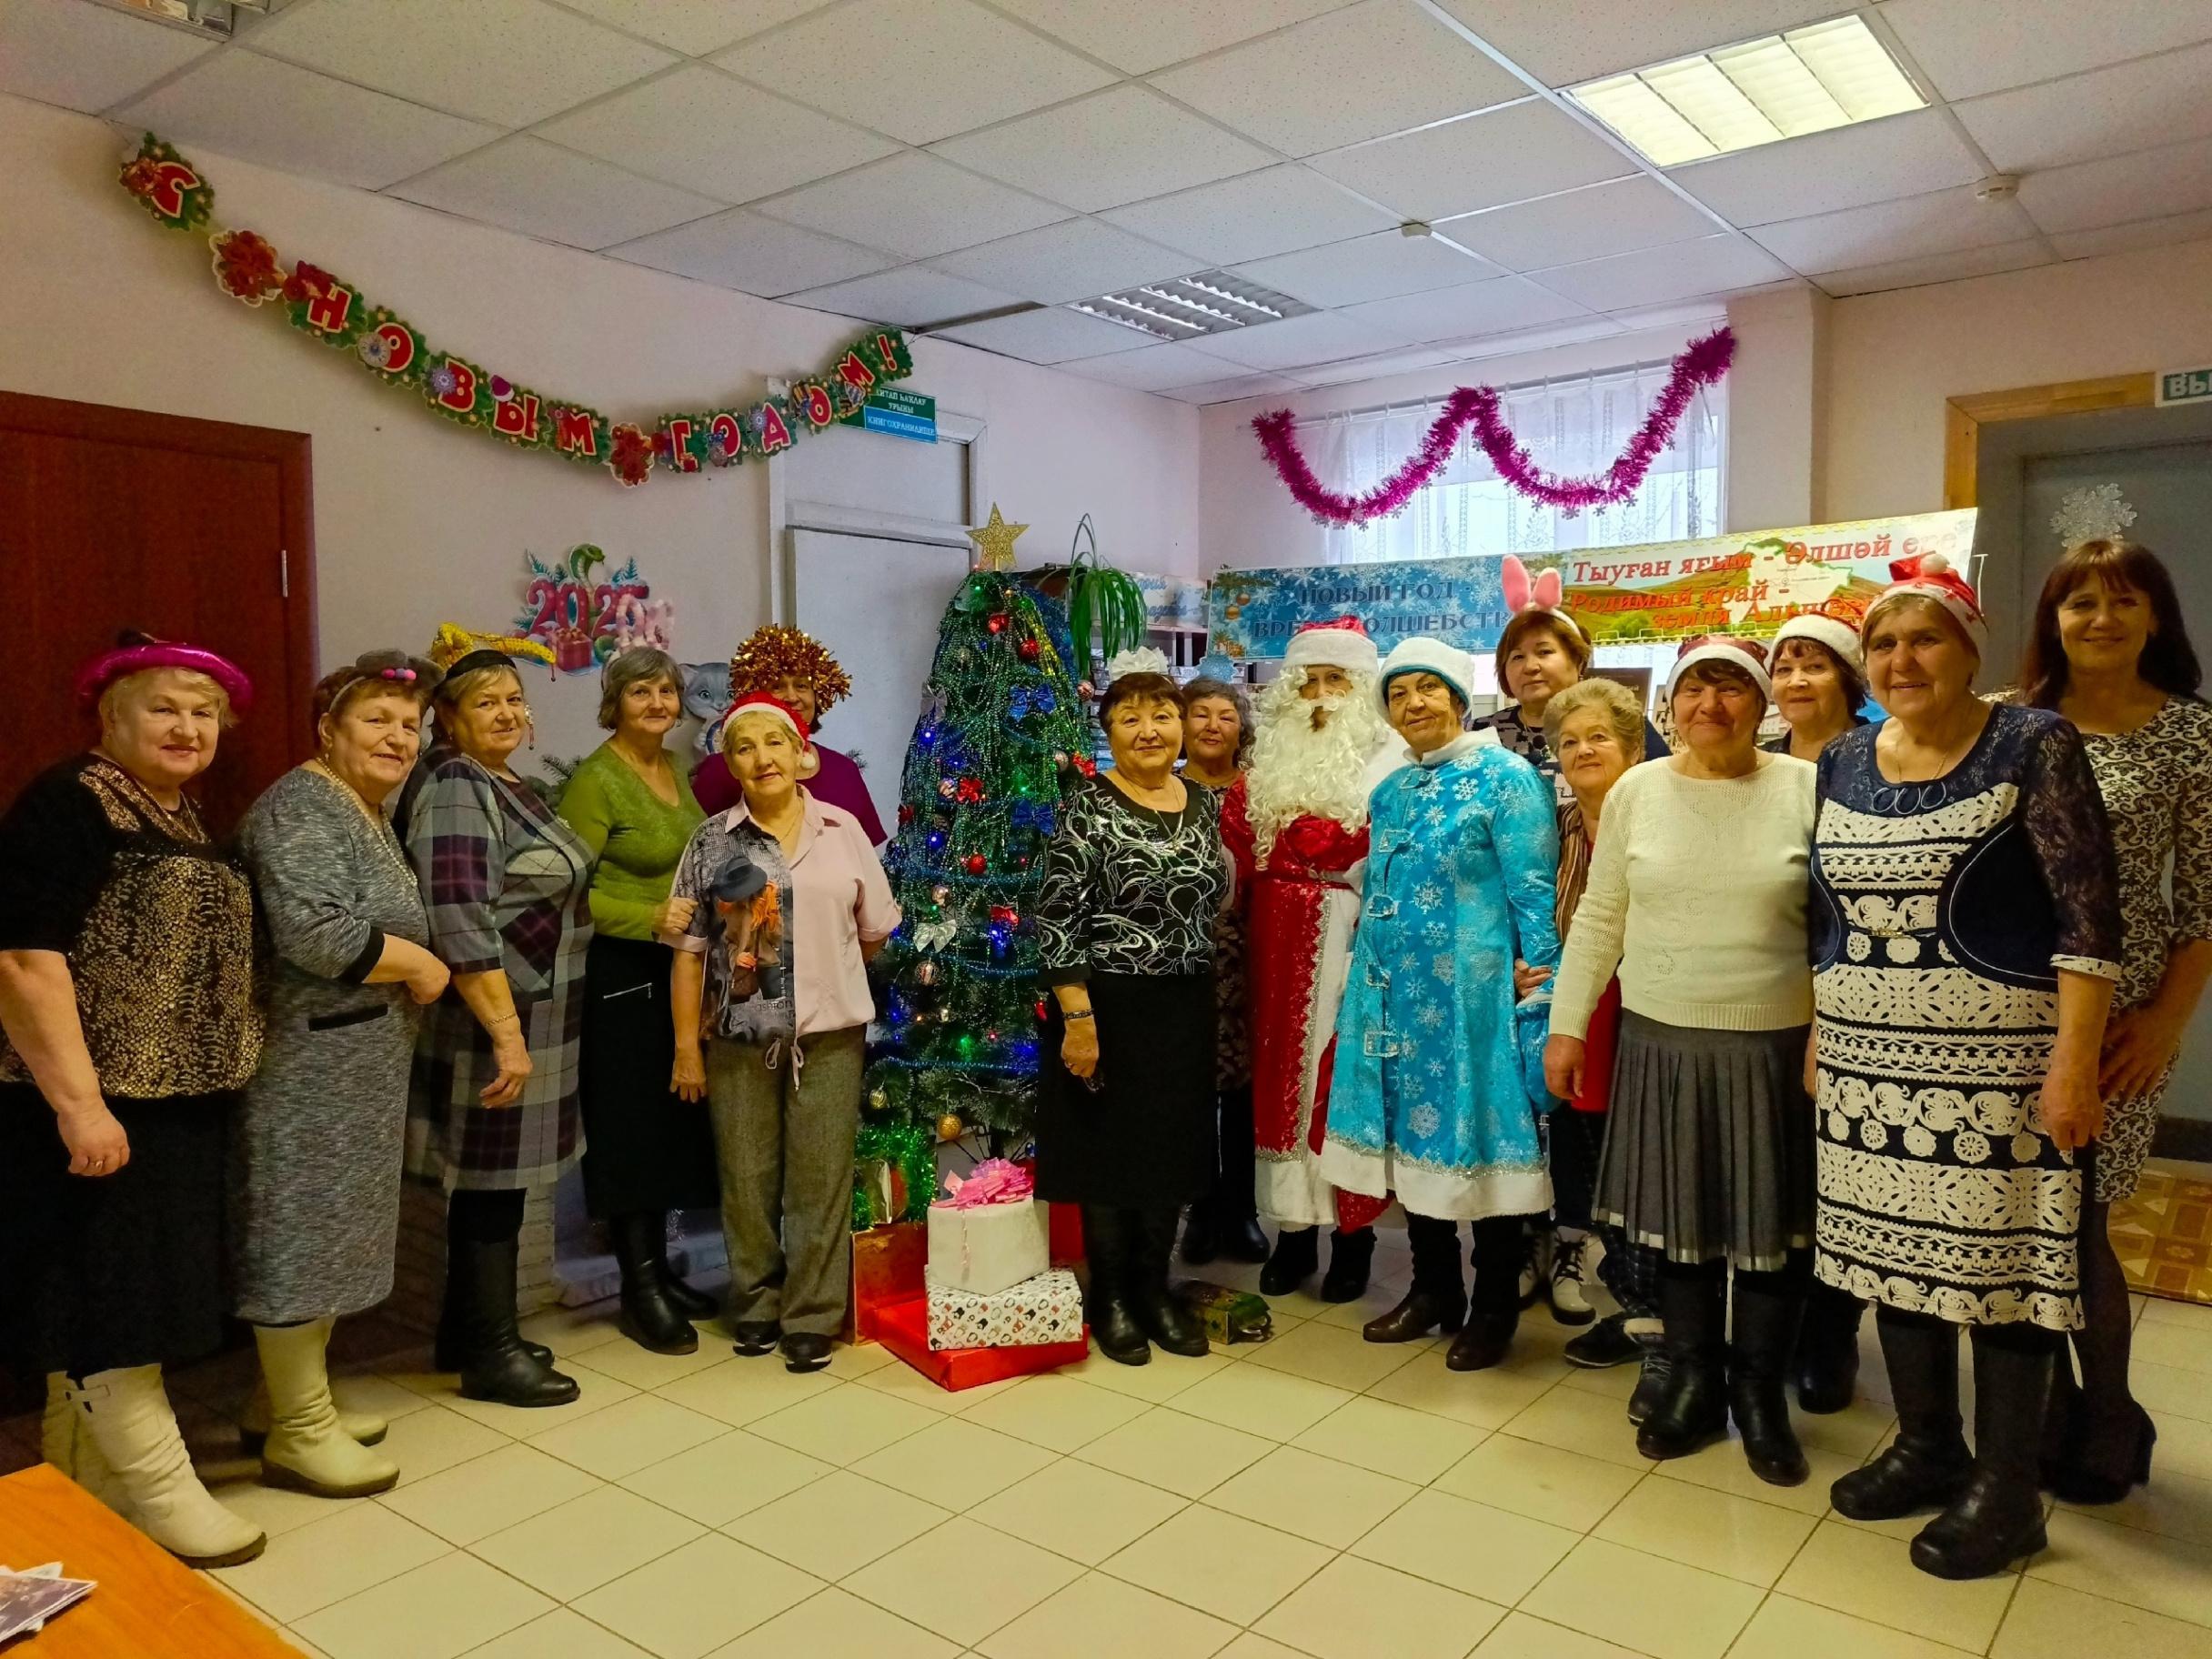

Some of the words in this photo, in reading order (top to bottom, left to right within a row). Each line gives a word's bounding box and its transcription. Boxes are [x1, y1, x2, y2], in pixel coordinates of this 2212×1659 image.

[151, 161, 201, 218] С
[306, 283, 598, 456] НОВЫМ
[669, 334, 899, 466] ГОДОМ!
[878, 389, 899, 400] ИТАП
[1300, 581, 1391, 606] НОВЫЙ
[1401, 580, 1454, 600] ГОД
[1571, 587, 1693, 615] Родимый
[1702, 579, 1769, 609] край
[1363, 610, 1512, 634] ОЛШЕБСТВ
[1652, 608, 1732, 628] земля
